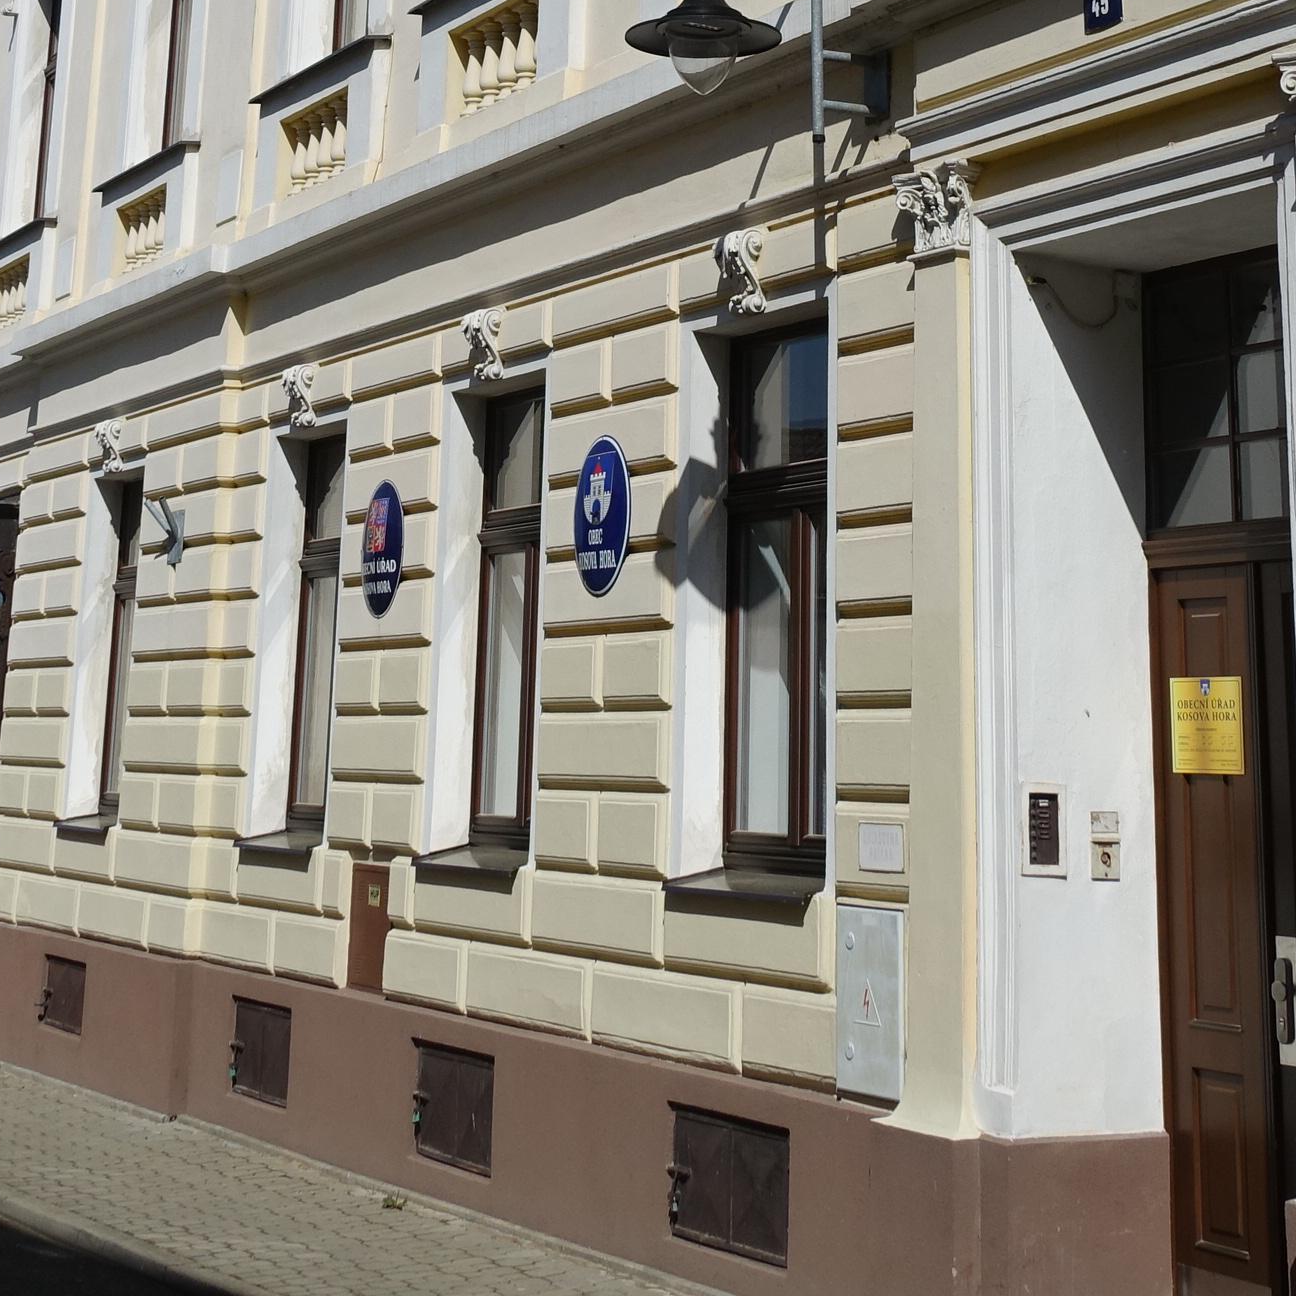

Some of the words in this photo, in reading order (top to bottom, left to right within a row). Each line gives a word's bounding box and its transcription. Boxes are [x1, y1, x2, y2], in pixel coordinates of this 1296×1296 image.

[587, 528, 603, 545] OBEC
[599, 549, 616, 568] HORA
[1177, 697, 1208, 710] OBECNÍ
[1211, 696, 1235, 709] ÚŘAD
[1177, 711, 1209, 721] KOSOVA
[1212, 711, 1237, 721] HORA
